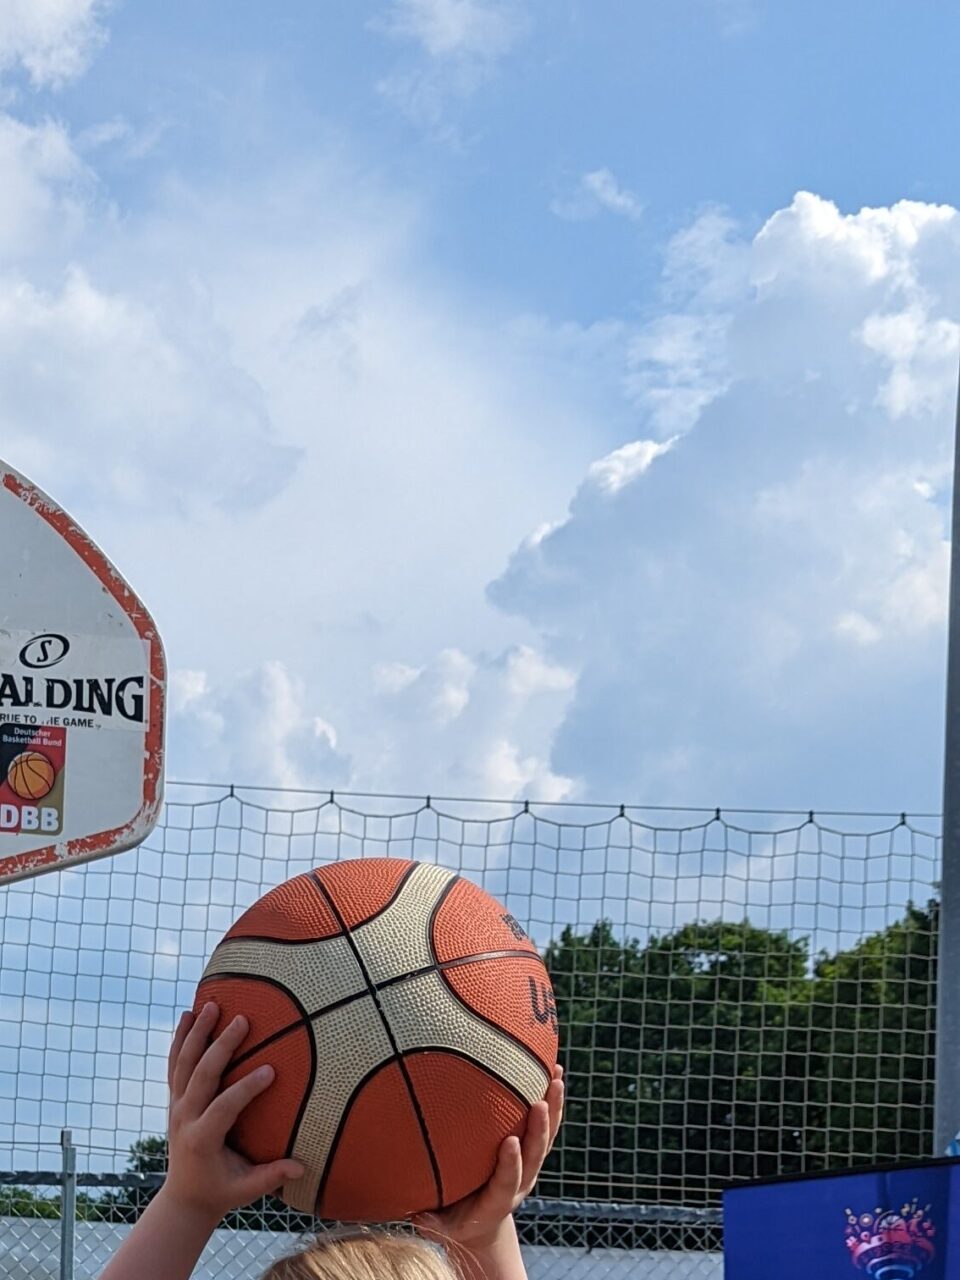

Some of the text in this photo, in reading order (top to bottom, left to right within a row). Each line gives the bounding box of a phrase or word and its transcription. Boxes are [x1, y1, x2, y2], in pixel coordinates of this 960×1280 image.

[23, 714, 37, 724] TO
[62, 717, 94, 728] GAME
[14, 727, 51, 737] Deutscher
[2, 735, 62, 747] Basketball Bund
[0, 804, 60, 831] DBB
